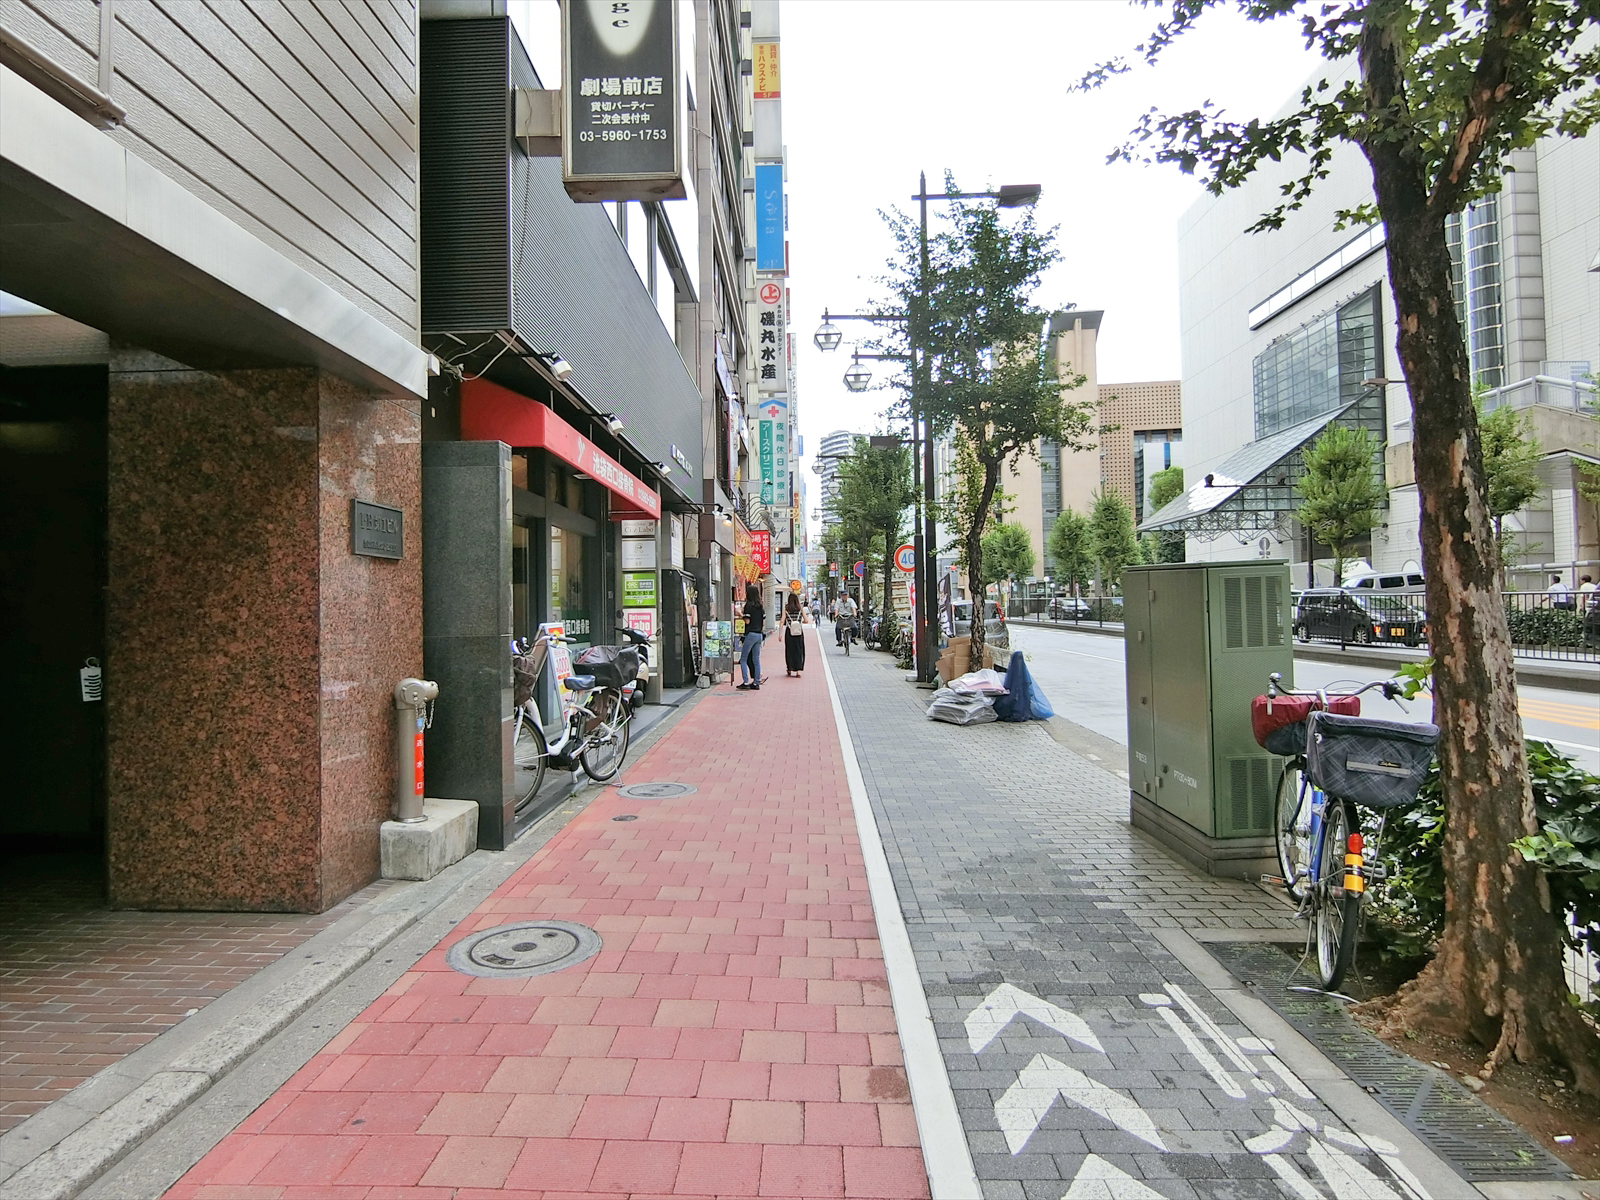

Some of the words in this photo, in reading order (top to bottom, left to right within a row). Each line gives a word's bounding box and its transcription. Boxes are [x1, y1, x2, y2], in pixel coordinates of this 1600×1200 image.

[580, 76, 663, 96] 劇場前店
[591, 113, 651, 125] 二次会受付中
[580, 129, 667, 142] 03-5960-1753
[760, 311, 776, 379] 磯丸水産
[776, 422, 785, 501] 夜間休日診療所
[901, 552, 915, 565] 40
